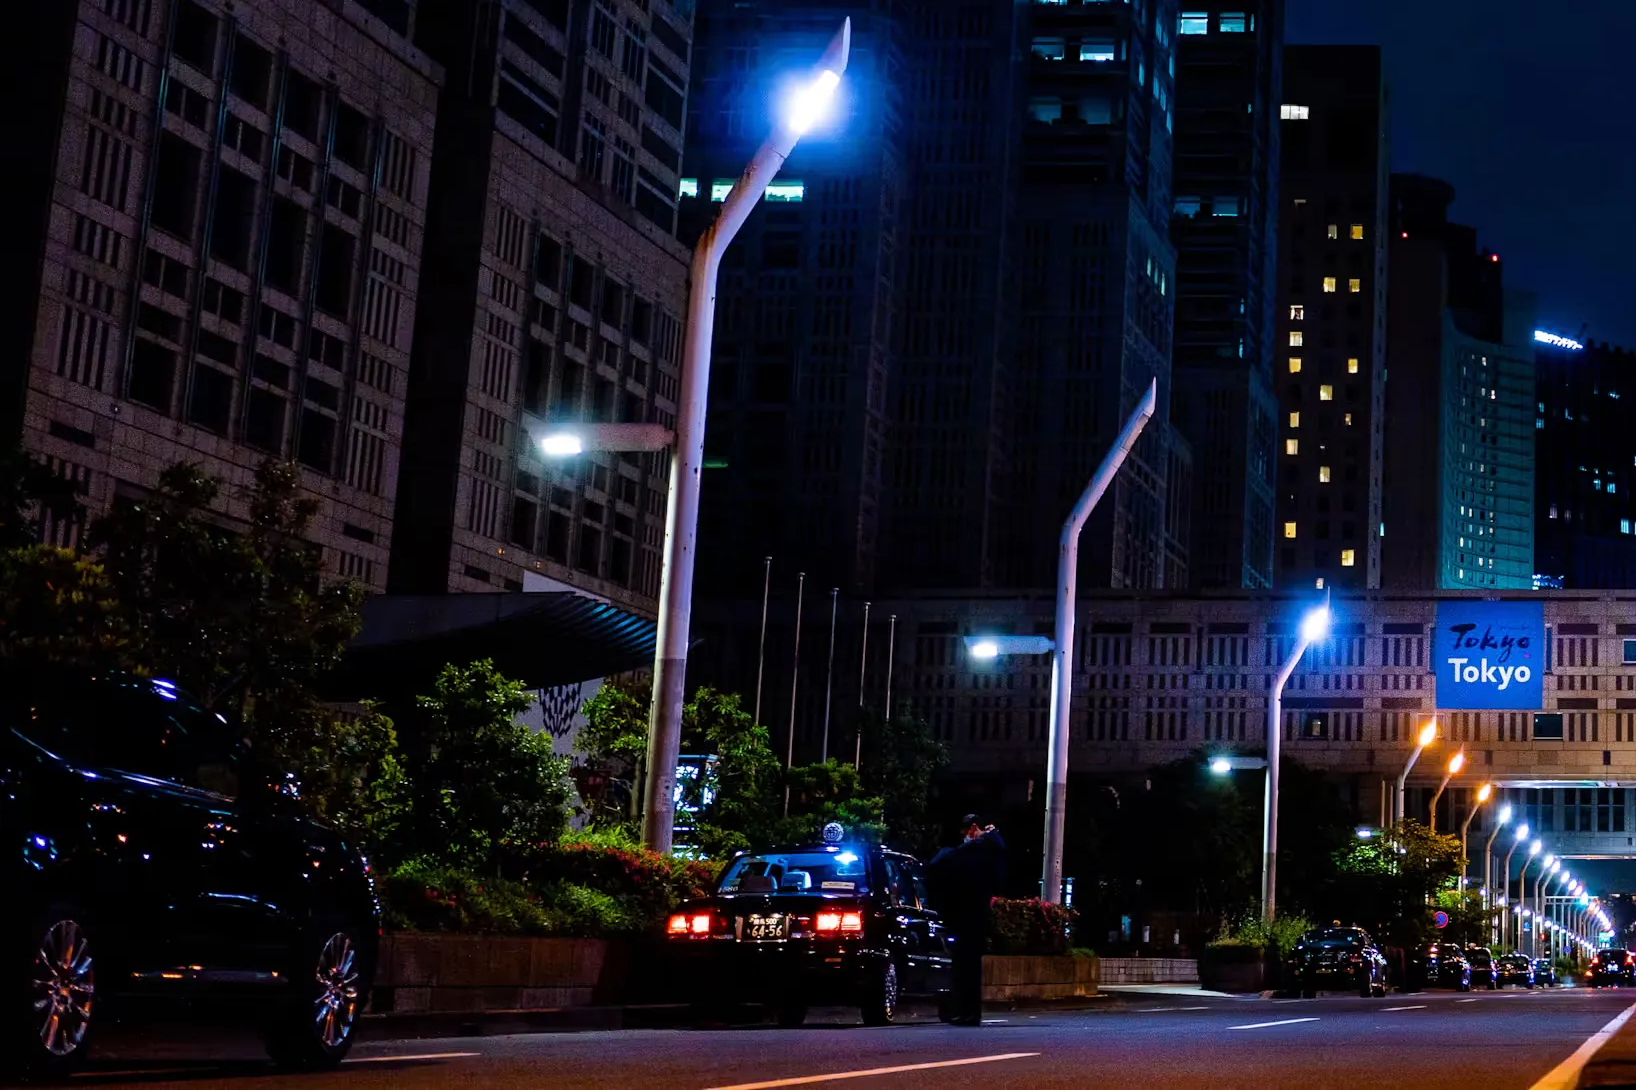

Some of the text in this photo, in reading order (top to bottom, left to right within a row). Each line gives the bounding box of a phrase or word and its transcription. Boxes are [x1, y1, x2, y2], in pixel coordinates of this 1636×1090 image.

[1449, 623, 1530, 663] Tokyo
[1448, 658, 1531, 691] Tokyo
[751, 925, 782, 937] 64-56
